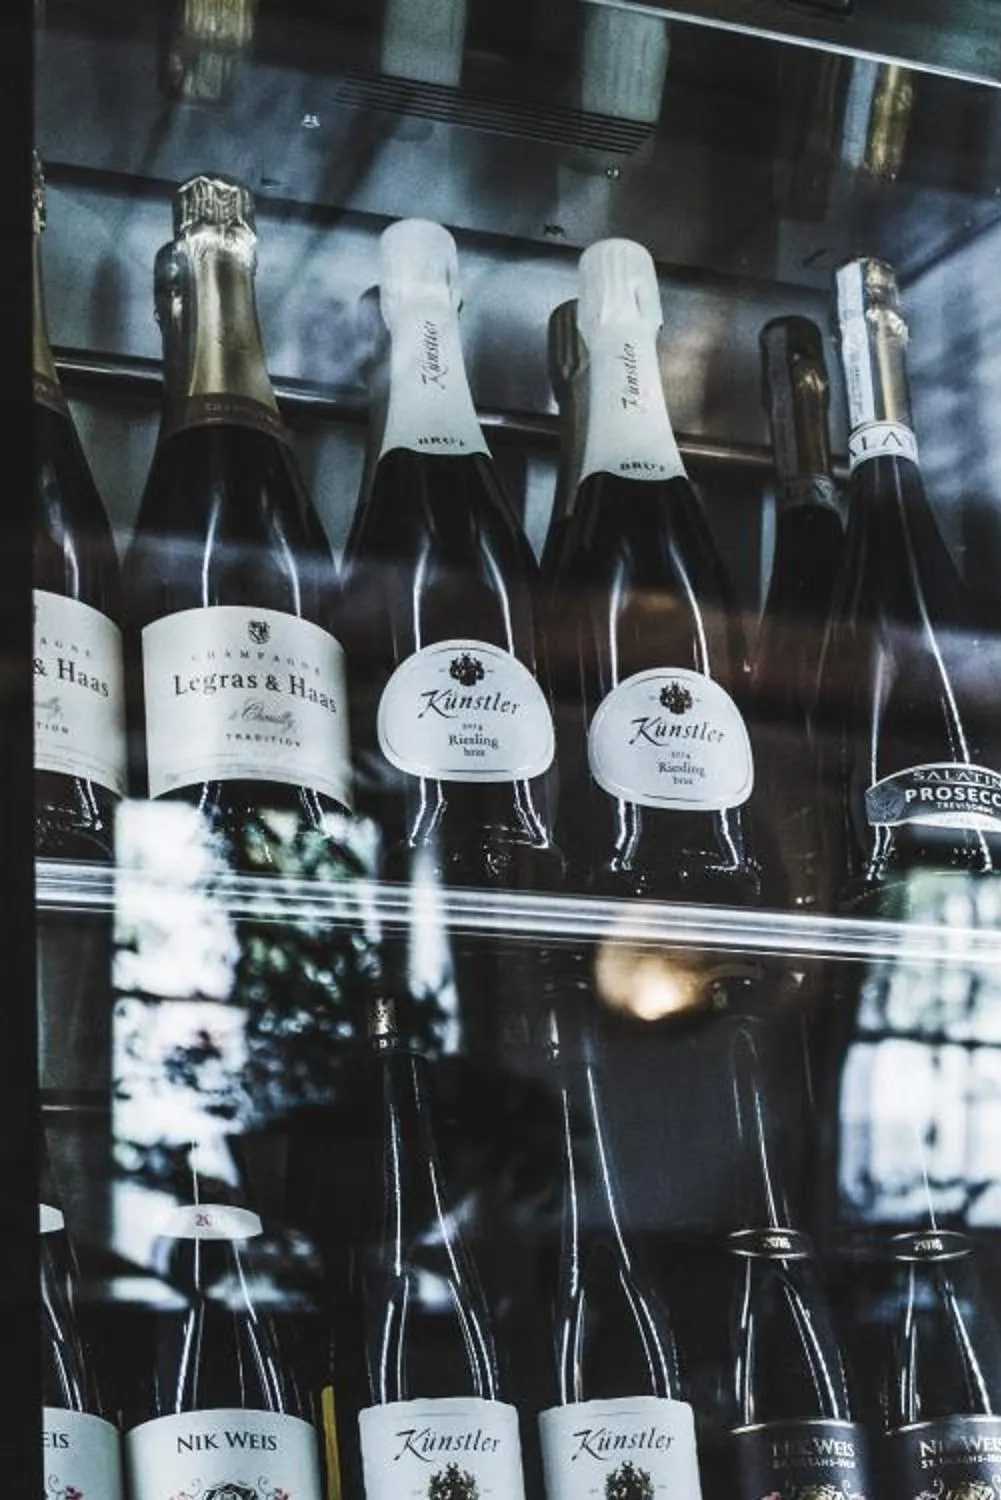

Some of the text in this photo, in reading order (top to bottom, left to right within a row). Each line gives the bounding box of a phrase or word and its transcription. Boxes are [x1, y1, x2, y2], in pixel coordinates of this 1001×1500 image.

[57, 657, 110, 698] Haas
[174, 673, 337, 714] Legras & Haas
[417, 688, 522, 719] Künstler
[448, 732, 500, 750] Riesling
[628, 716, 725, 747] Künstler
[657, 761, 708, 778] Riesling
[39, 1431, 70, 1451] EIS
[177, 1430, 279, 1454] NIK WEIS
[394, 1426, 502, 1462] Künstler
[571, 1426, 675, 1461] Künstler
